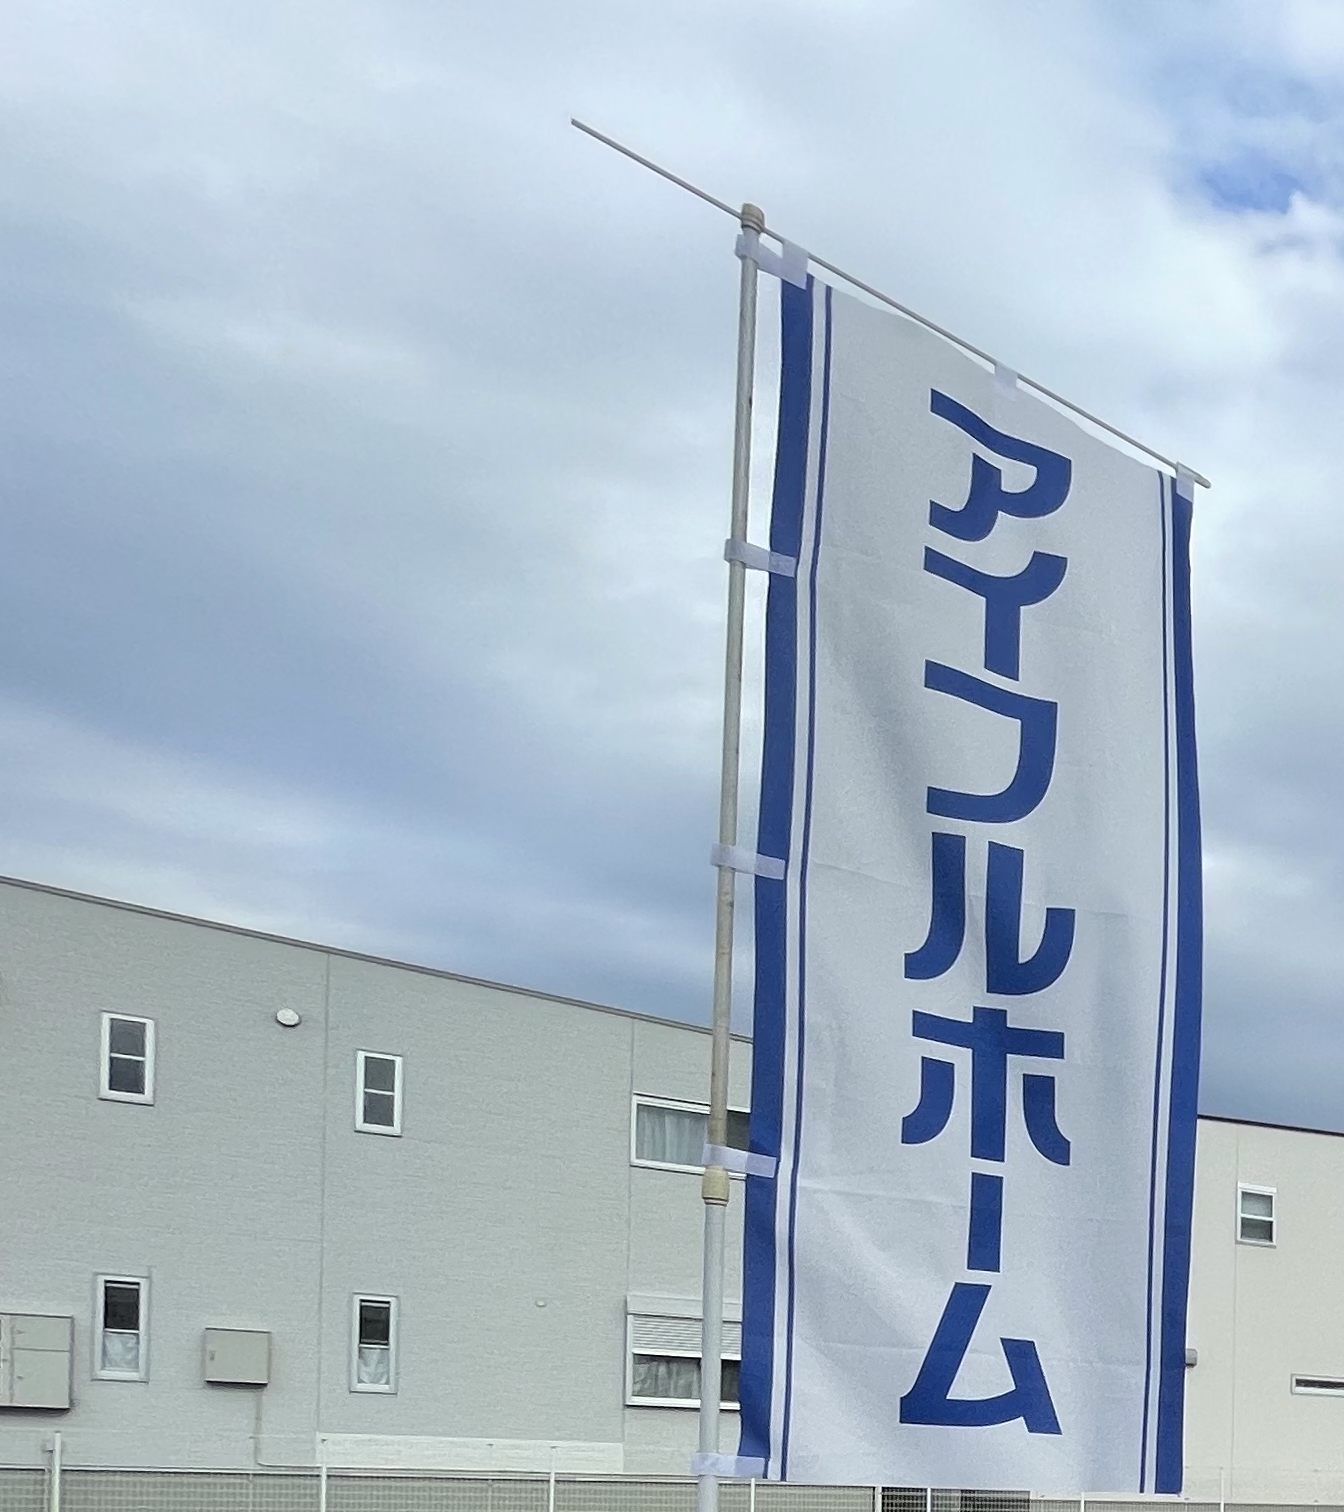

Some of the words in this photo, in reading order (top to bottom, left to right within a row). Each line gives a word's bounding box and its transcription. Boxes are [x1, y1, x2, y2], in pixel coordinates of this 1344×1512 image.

[900, 388, 1074, 1435] アイフルホーム
